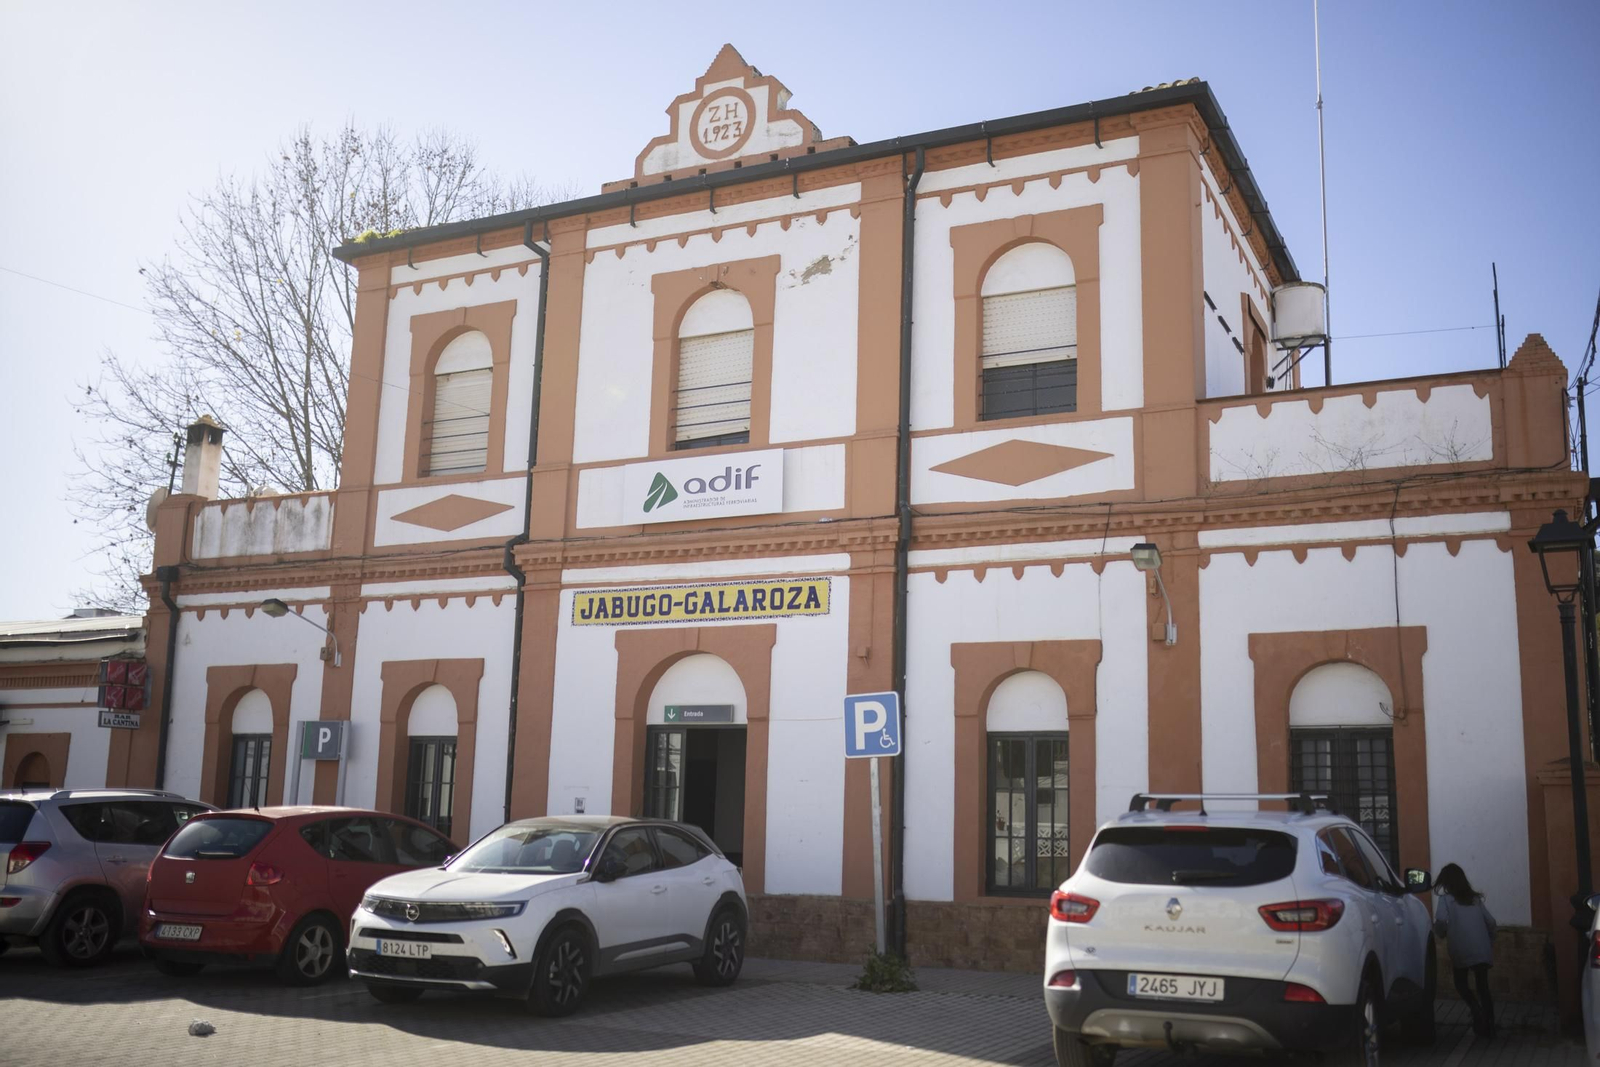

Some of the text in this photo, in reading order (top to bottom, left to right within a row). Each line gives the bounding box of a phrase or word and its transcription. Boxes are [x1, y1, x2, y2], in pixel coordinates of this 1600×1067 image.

[683, 464, 761, 494] adif
[580, 585, 821, 620] JABUGO-GALAROZA
[112, 718, 139, 727] CANTINA
[854, 701, 887, 750] P
[317, 727, 331, 753] P
[161, 926, 200, 938] 4133 CXP
[382, 942, 429, 957] 8124 LTP
[1139, 977, 1217, 997] 2465 JYJ
